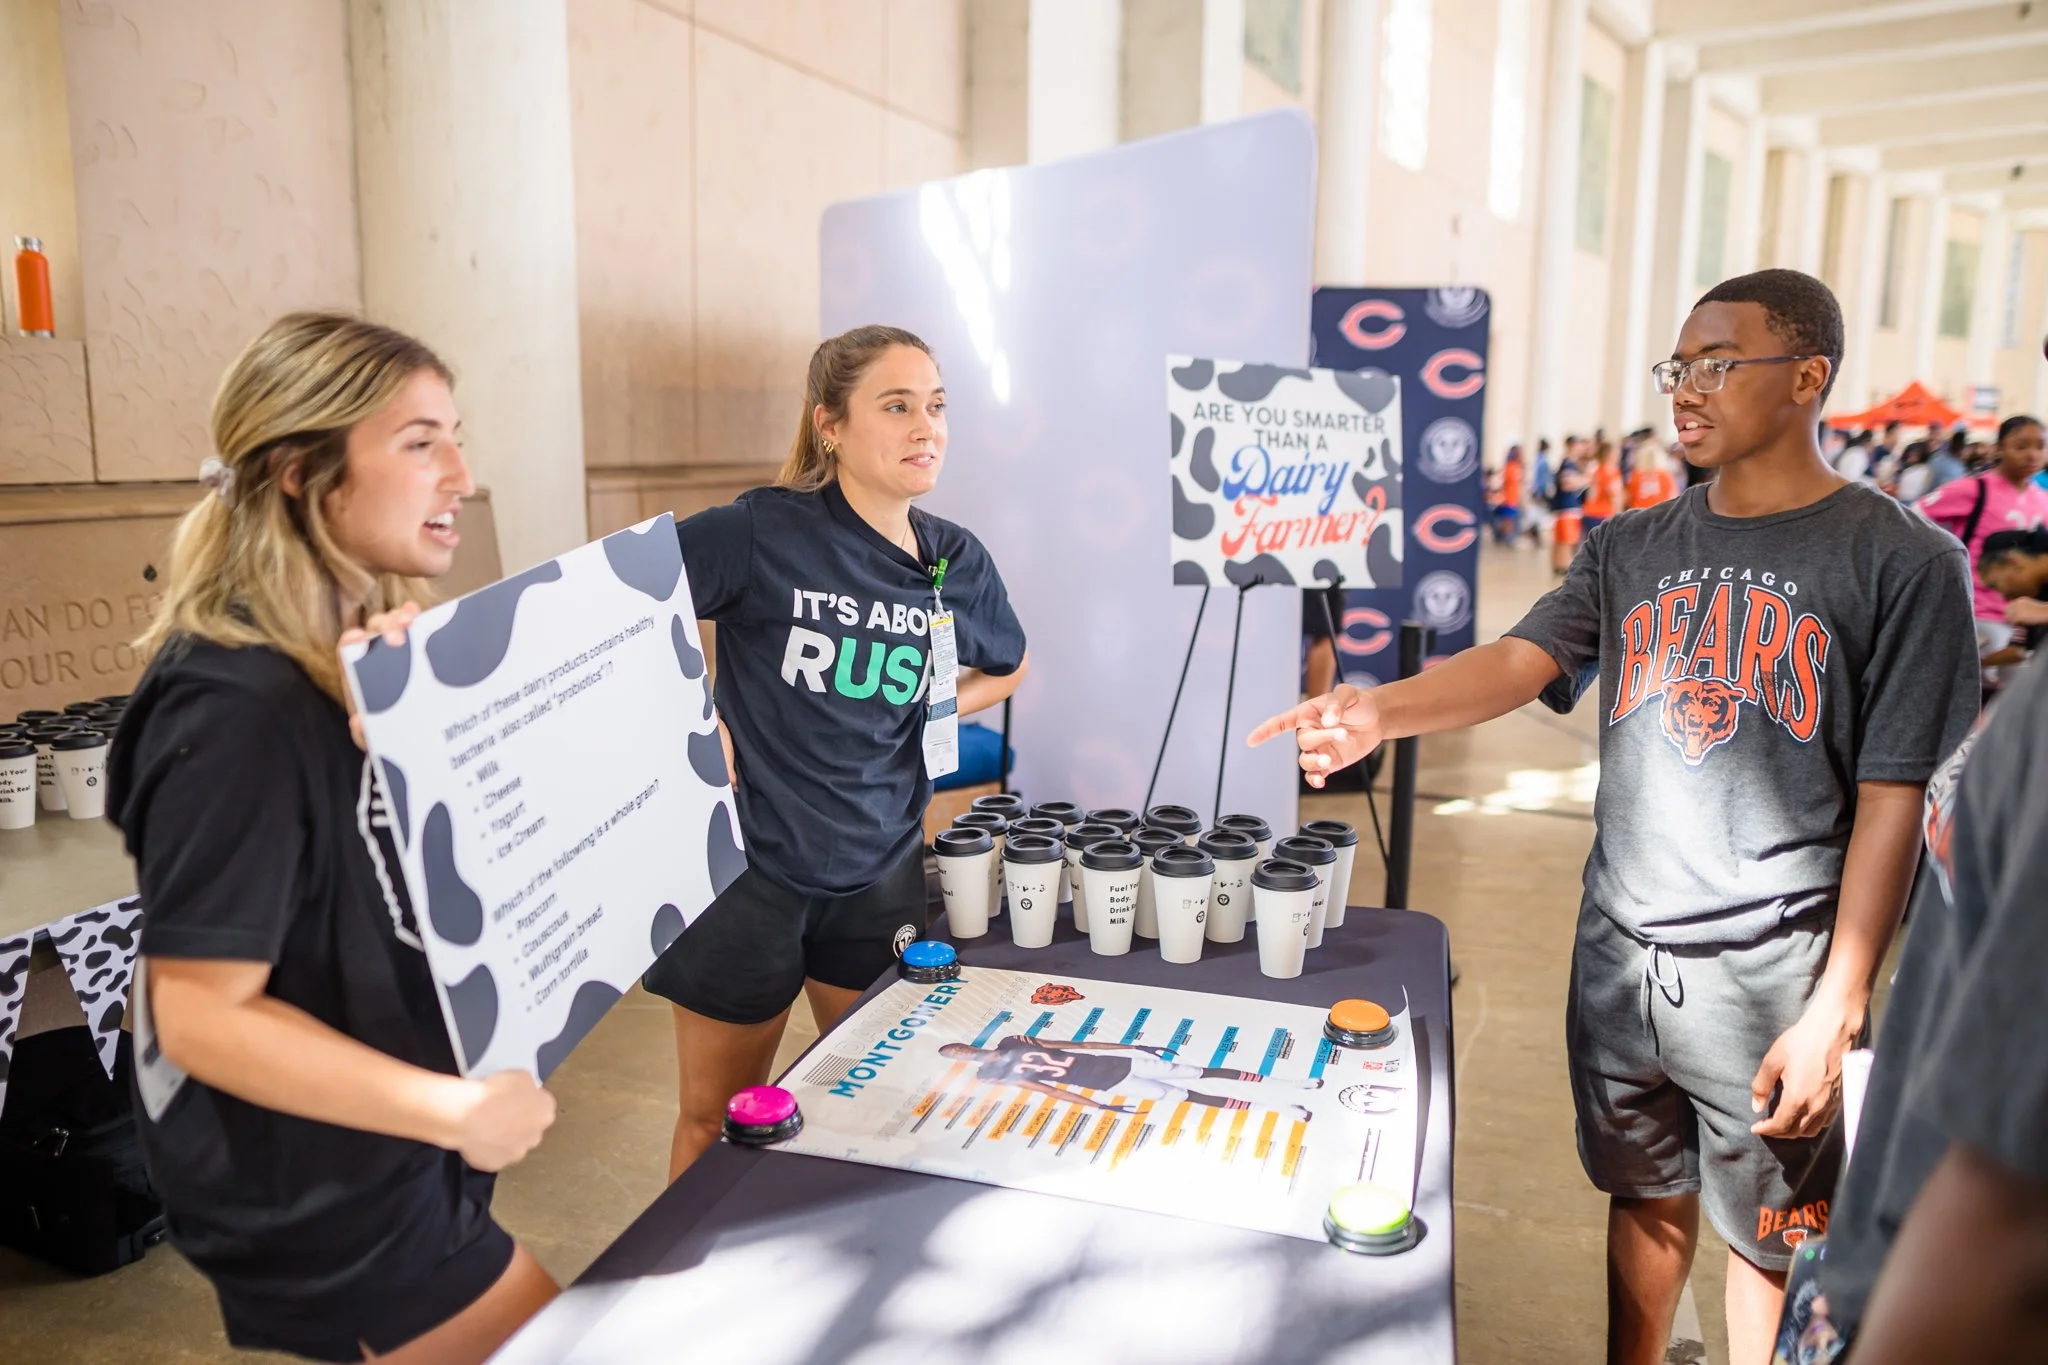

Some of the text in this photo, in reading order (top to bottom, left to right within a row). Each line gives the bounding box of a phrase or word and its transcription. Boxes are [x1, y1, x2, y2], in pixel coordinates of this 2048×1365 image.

[1192, 402, 1385, 435] ARE YOU SMARTER
[1253, 428, 1329, 451] THAN A
[1221, 444, 1349, 516] Dairy
[1220, 485, 1387, 558] Farmer?
[1657, 566, 1798, 597] CHICAGO
[64, 597, 113, 632] DO
[793, 588, 930, 637] IT’S ABO
[443, 615, 655, 743] Which of these dairy products contains healthy
[780, 625, 932, 706] RUS
[1609, 582, 1831, 743] BEARS
[450, 734, 496, 770] bacteria
[523, 694, 553, 725] called
[477, 760, 500, 783] Milk
[484, 777, 522, 809] Cheese
[490, 802, 526, 832] Yogurt
[513, 815, 547, 847] Cream
[492, 890, 524, 923] Which
[526, 879, 536, 893] of
[537, 868, 553, 886] the
[553, 833, 595, 872] following
[611, 801, 635, 825] whole
[635, 779, 659, 808] grain?
[1110, 884, 1128, 892] Fuel
[516, 892, 557, 930] Popcorn
[1110, 905, 1130, 914] Drink
[522, 911, 569, 956] Couscous
[528, 905, 604, 982] Multigrain bread
[534, 948, 589, 1005] Corn tortilla
[828, 976, 969, 1098] MONTGOMERY
[1014, 1048, 1076, 1083] 32
[1757, 1200, 1828, 1241] BEARS
